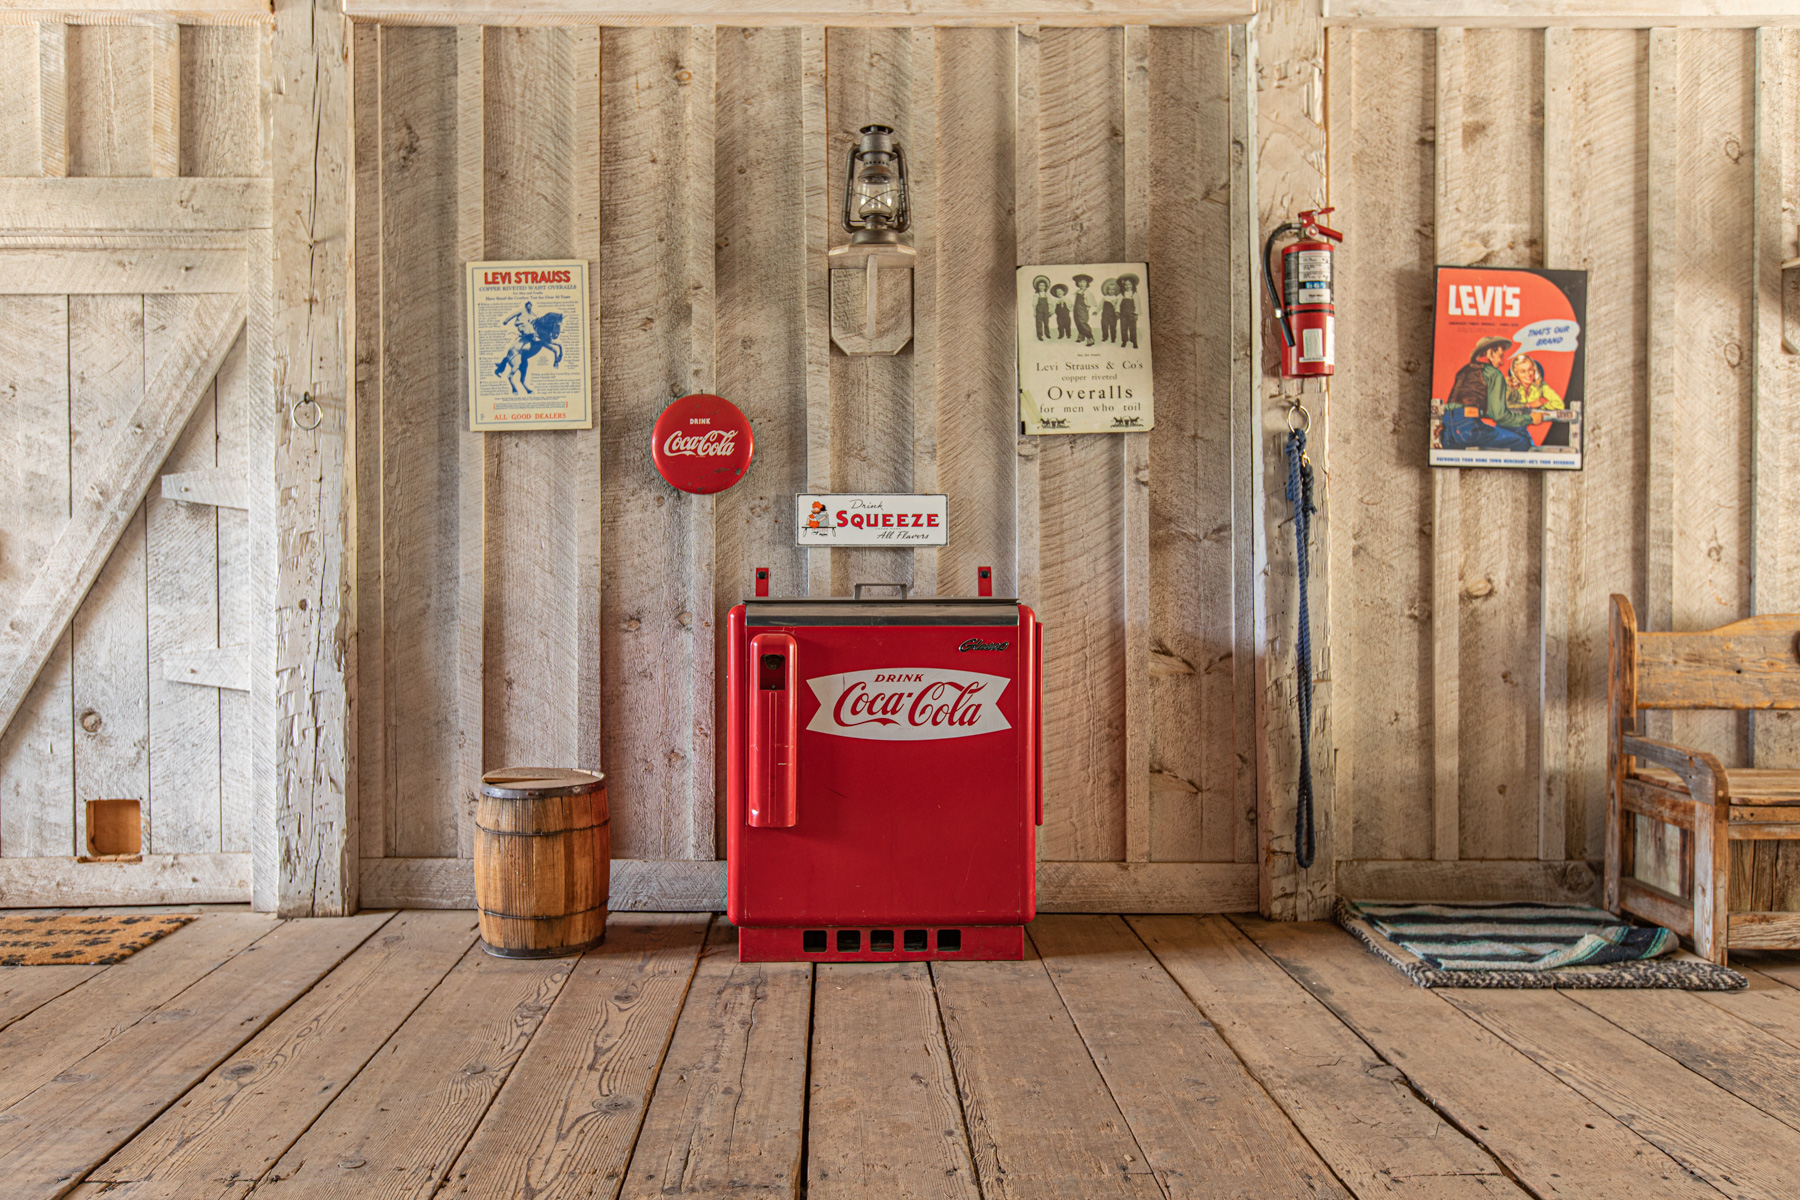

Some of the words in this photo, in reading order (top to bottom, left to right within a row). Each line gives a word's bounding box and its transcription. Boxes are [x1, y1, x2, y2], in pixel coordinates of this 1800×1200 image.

[484, 272, 511, 285] LEVI
[514, 270, 571, 284] STRAUSS
[1448, 285, 1520, 317] LEVI'S
[1554, 326, 1570, 334] OUR
[1536, 337, 1563, 346] BRAND
[1036, 362, 1058, 371] Levi
[1065, 362, 1099, 371] Strauss
[1106, 362, 1115, 370] &
[1122, 360, 1144, 369] Co's
[1047, 385, 1133, 400] Overalls
[1040, 404, 1054, 413] for
[1093, 402, 1114, 412] who
[1123, 402, 1141, 411] toil
[663, 430, 738, 456] Coca-Cola
[849, 499, 883, 511] Drink
[836, 510, 940, 530] SQUEEZE
[877, 531, 893, 539] All
[896, 531, 929, 539] Flavors
[874, 674, 924, 683] DRINK
[833, 682, 988, 727] Coca-Cola
